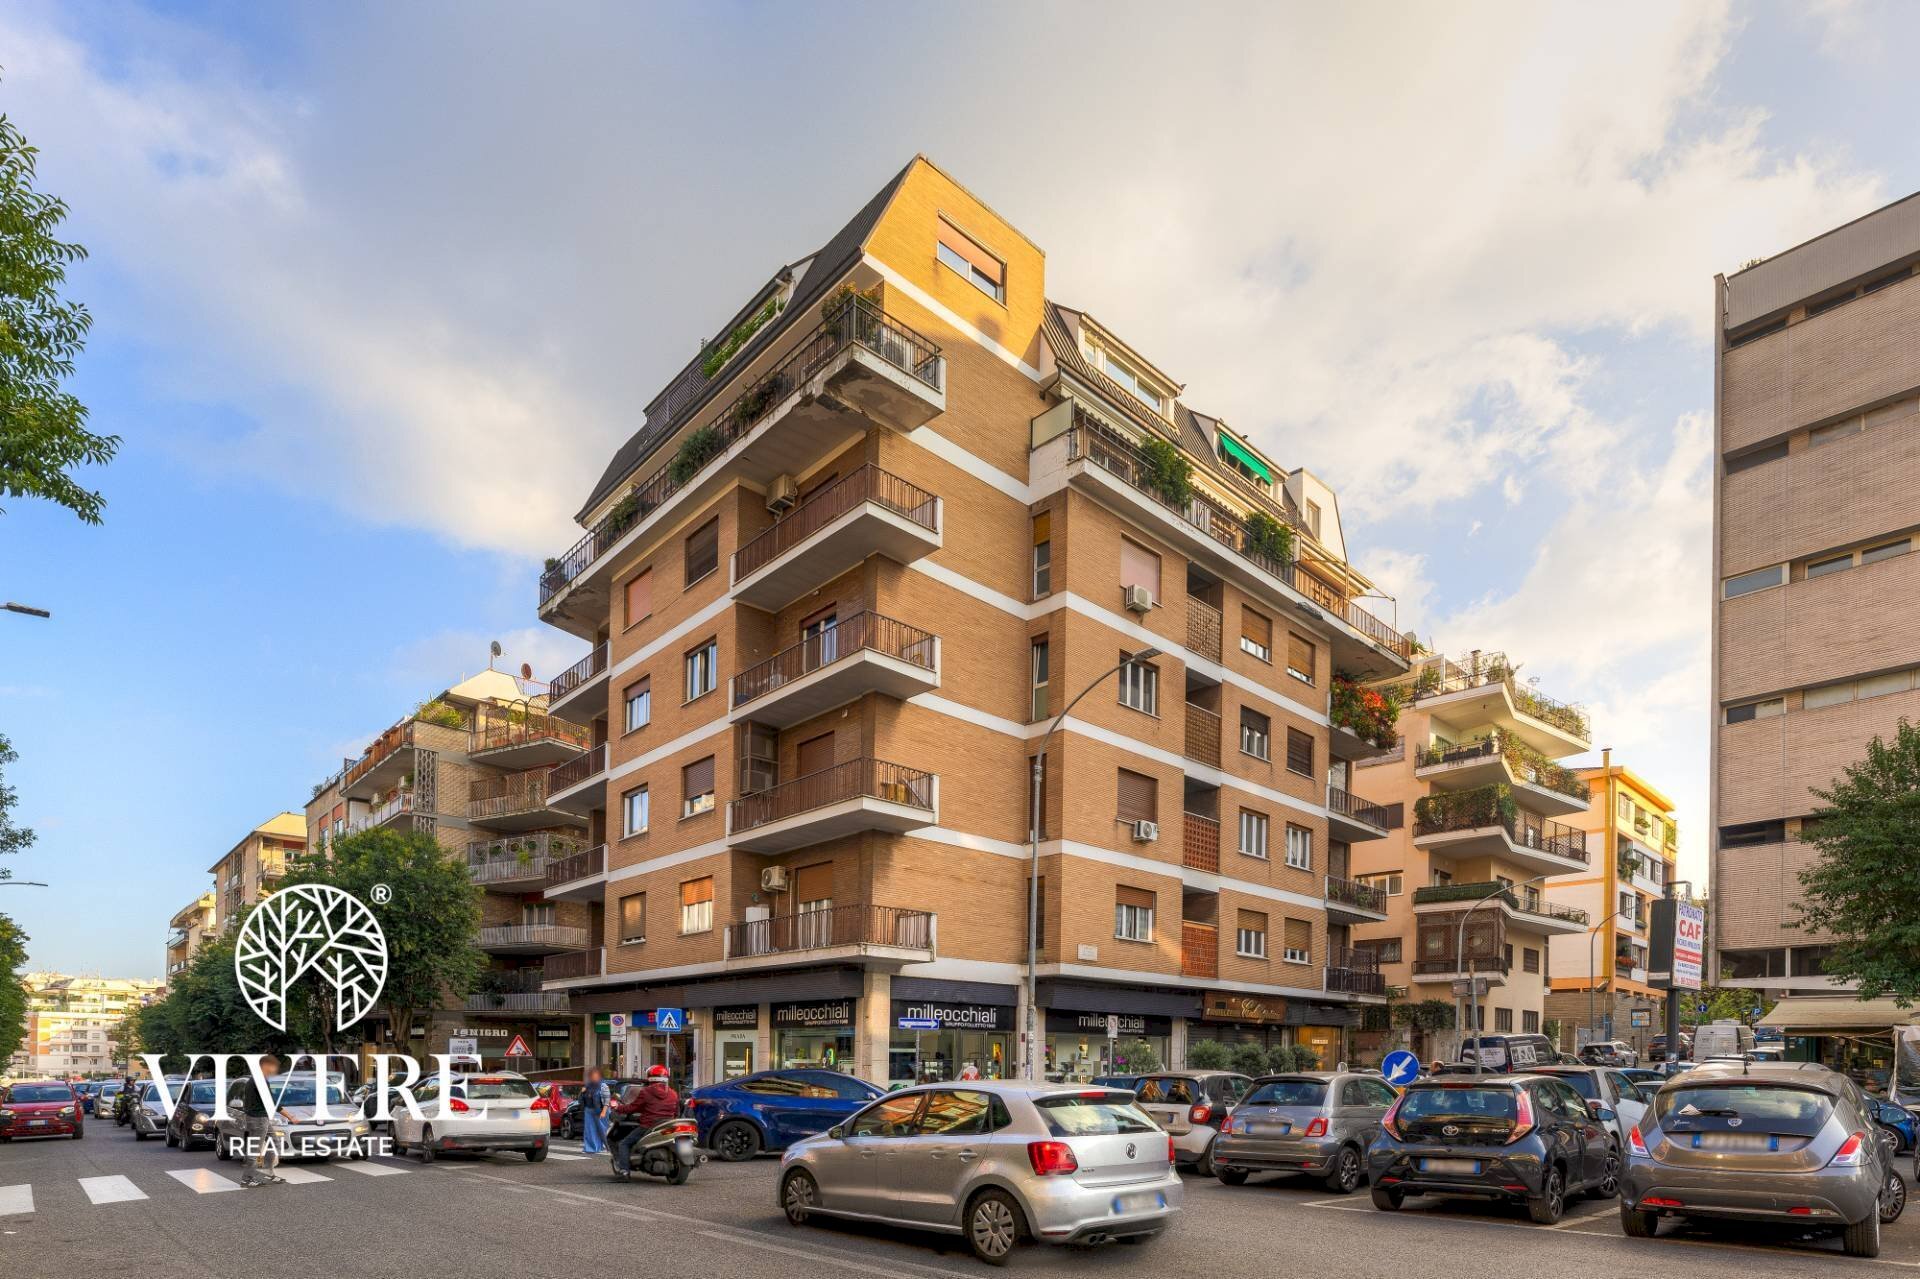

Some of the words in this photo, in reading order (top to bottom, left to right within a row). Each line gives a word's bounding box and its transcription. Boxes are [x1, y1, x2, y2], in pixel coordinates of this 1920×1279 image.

[1679, 919, 1701, 940] CAF
[777, 1001, 849, 1021] milleocchiali
[907, 1004, 997, 1023] milleocchiali
[1078, 1013, 1145, 1029] millechiali
